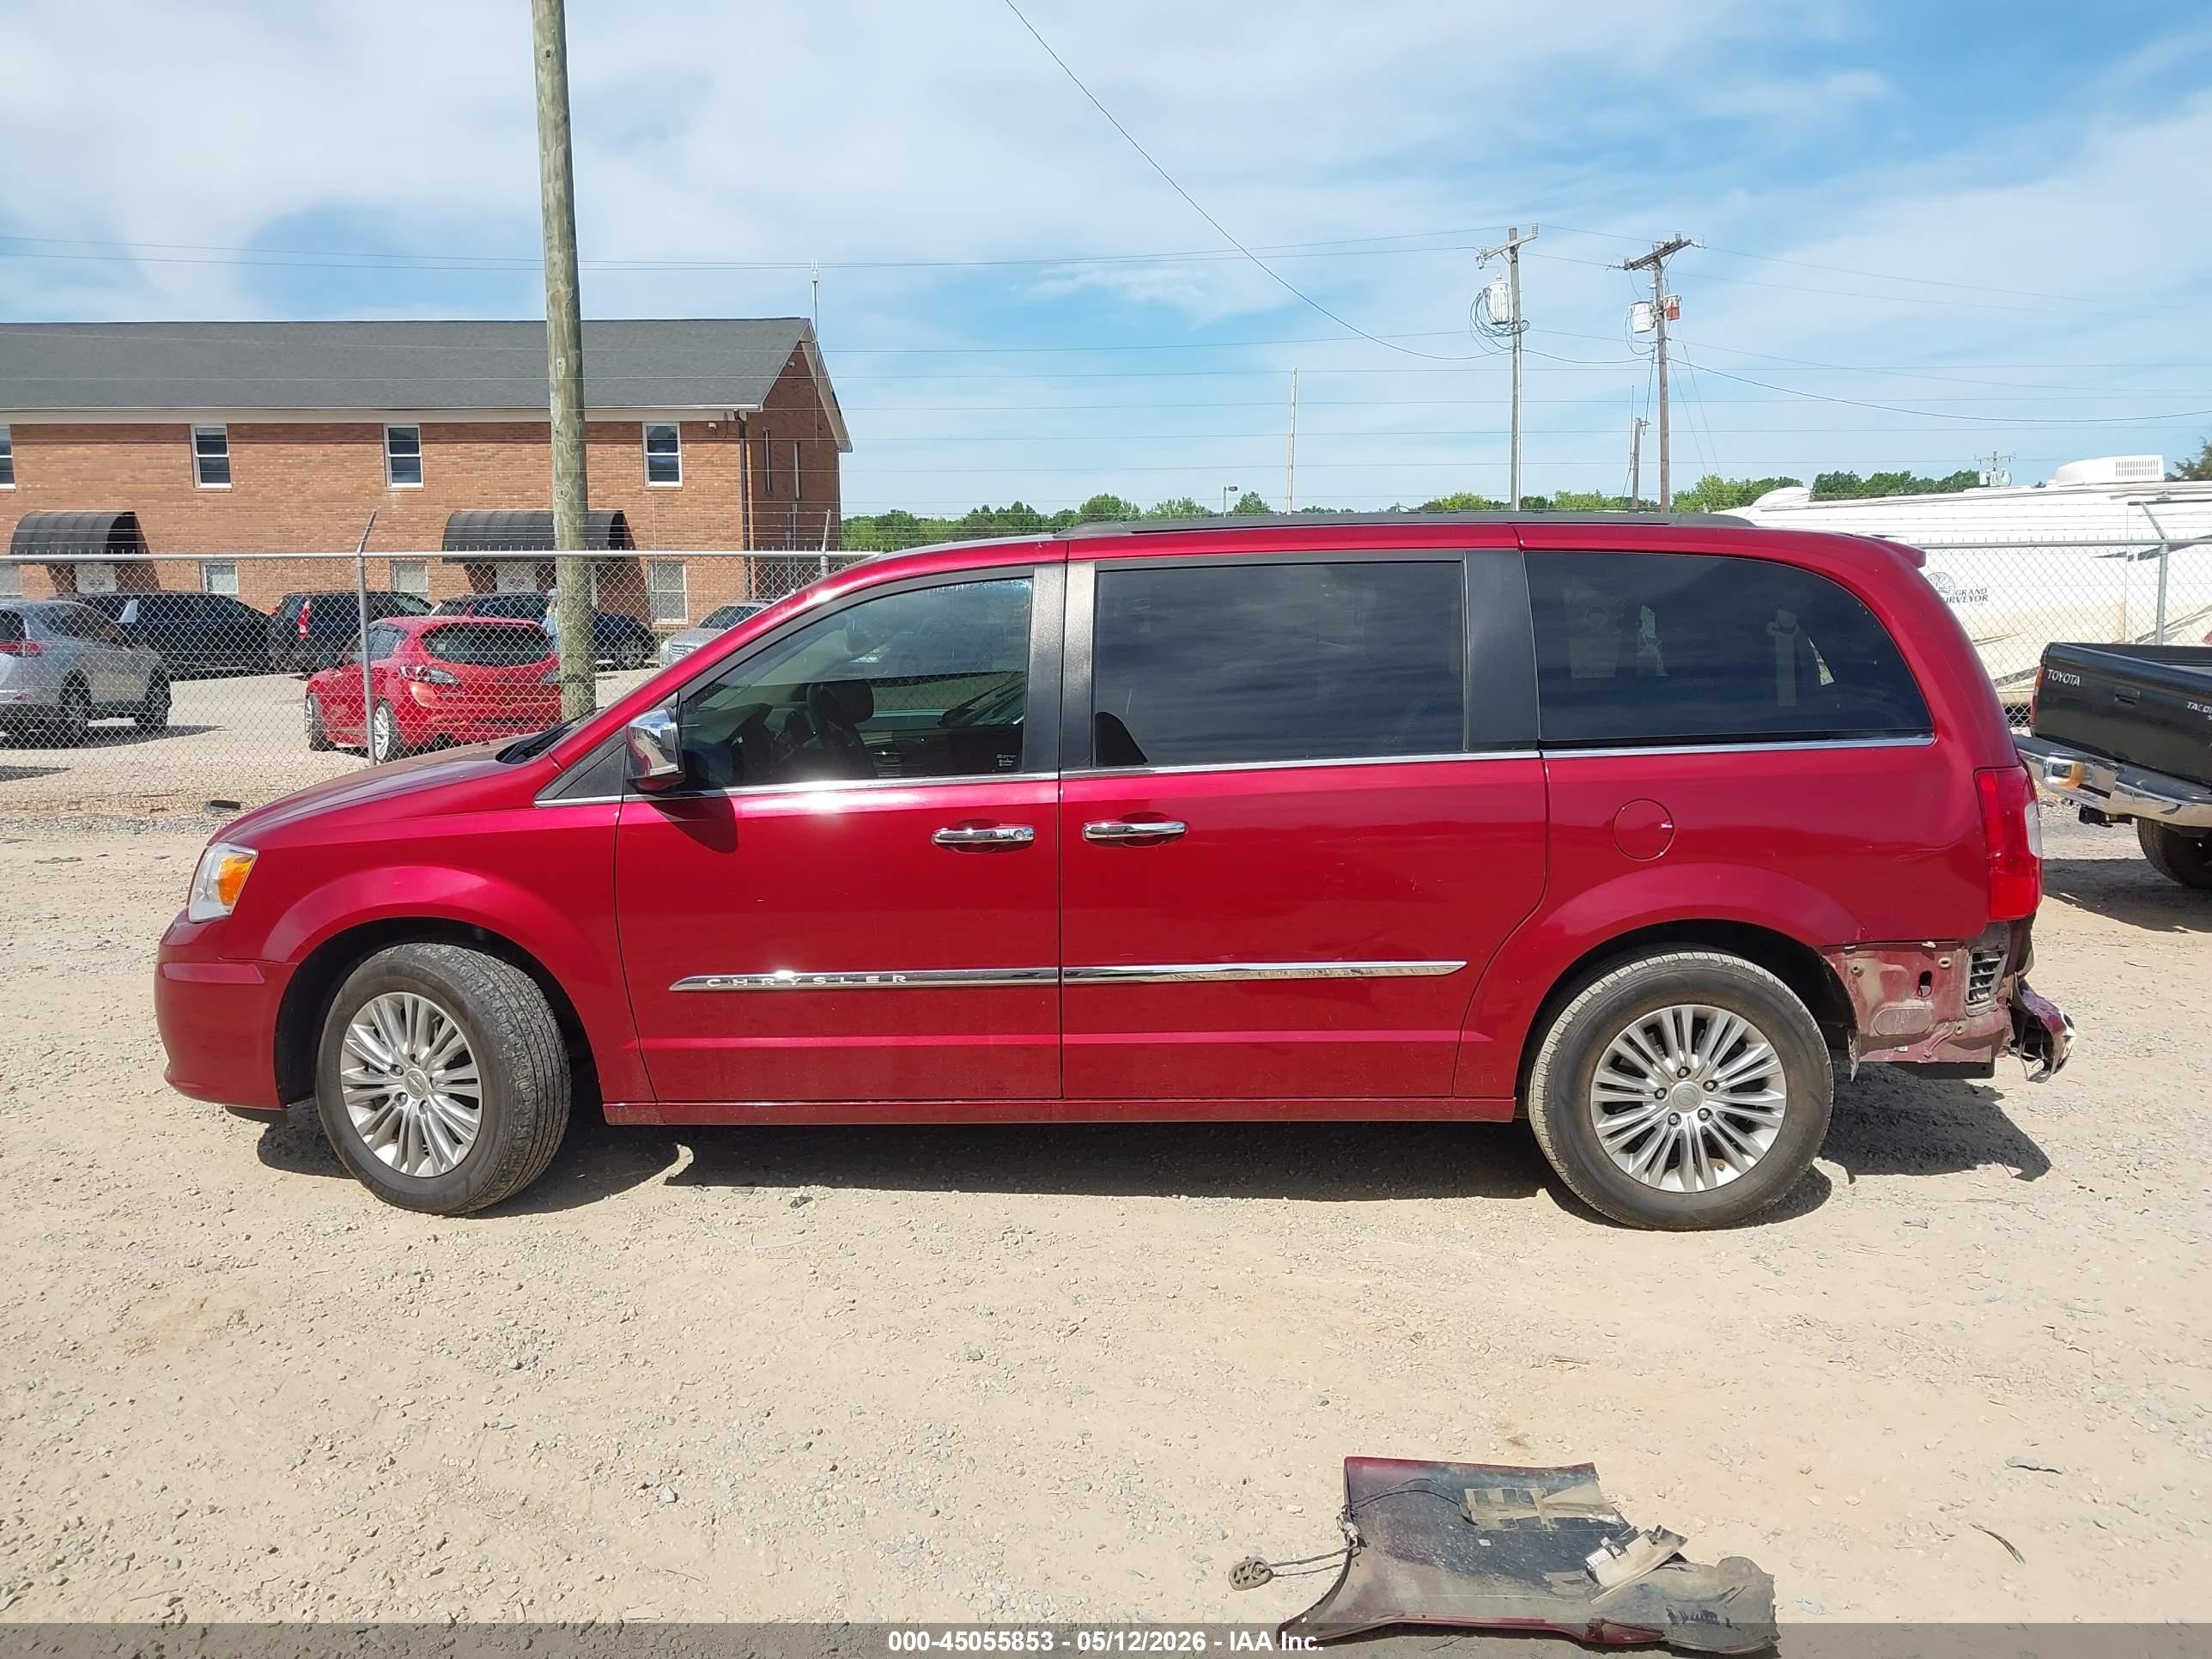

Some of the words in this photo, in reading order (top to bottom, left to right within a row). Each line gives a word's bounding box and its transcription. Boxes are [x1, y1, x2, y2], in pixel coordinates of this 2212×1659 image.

[1954, 587, 1988, 596] GRAND
[2047, 668, 2081, 687] TOYOTA
[706, 975, 908, 988] CHRYSLER
